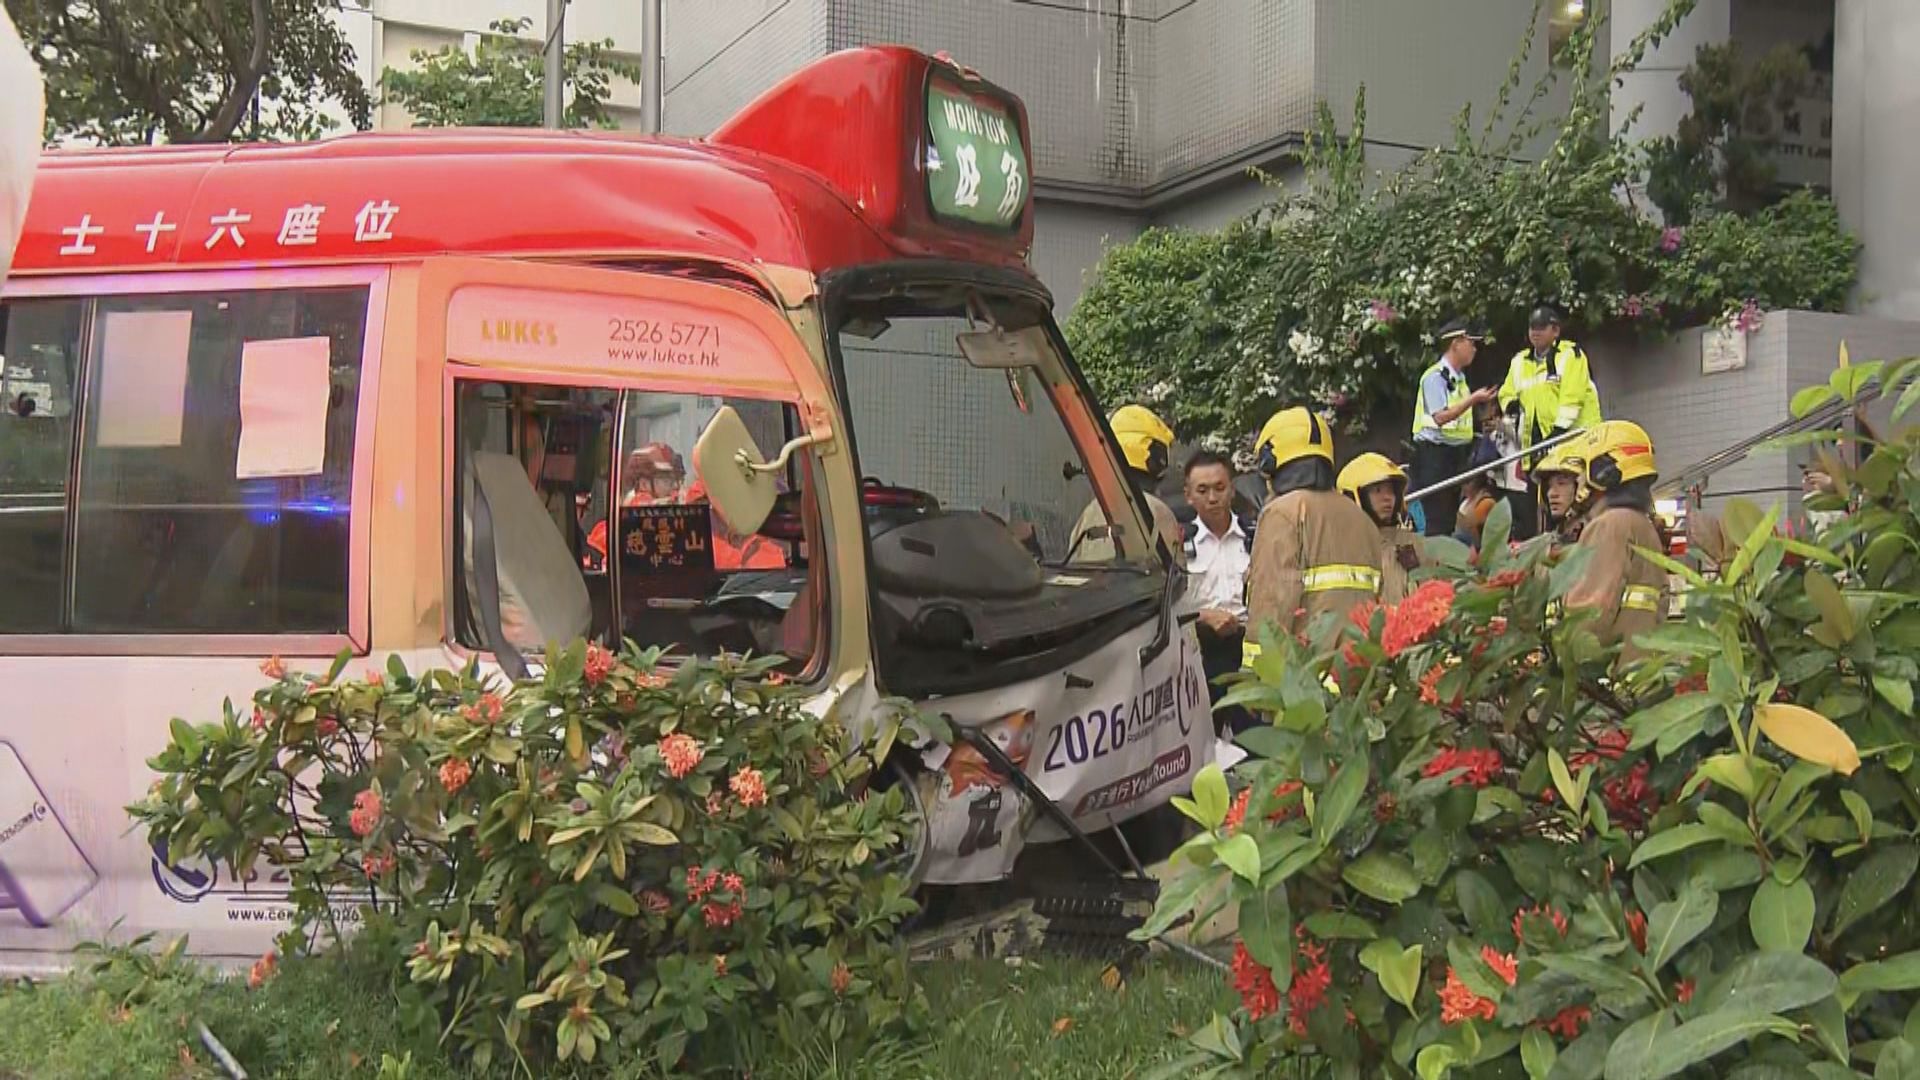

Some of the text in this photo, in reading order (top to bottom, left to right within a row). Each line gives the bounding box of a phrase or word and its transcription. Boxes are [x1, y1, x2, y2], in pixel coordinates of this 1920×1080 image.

[59, 199, 400, 256] 士十六座位
[481, 319, 558, 347] LUKES
[608, 318, 721, 348] 2526 5771
[608, 348, 720, 368] www.lukes.hk
[1044, 702, 1126, 773] 2026
[1153, 751, 1186, 782] Round
